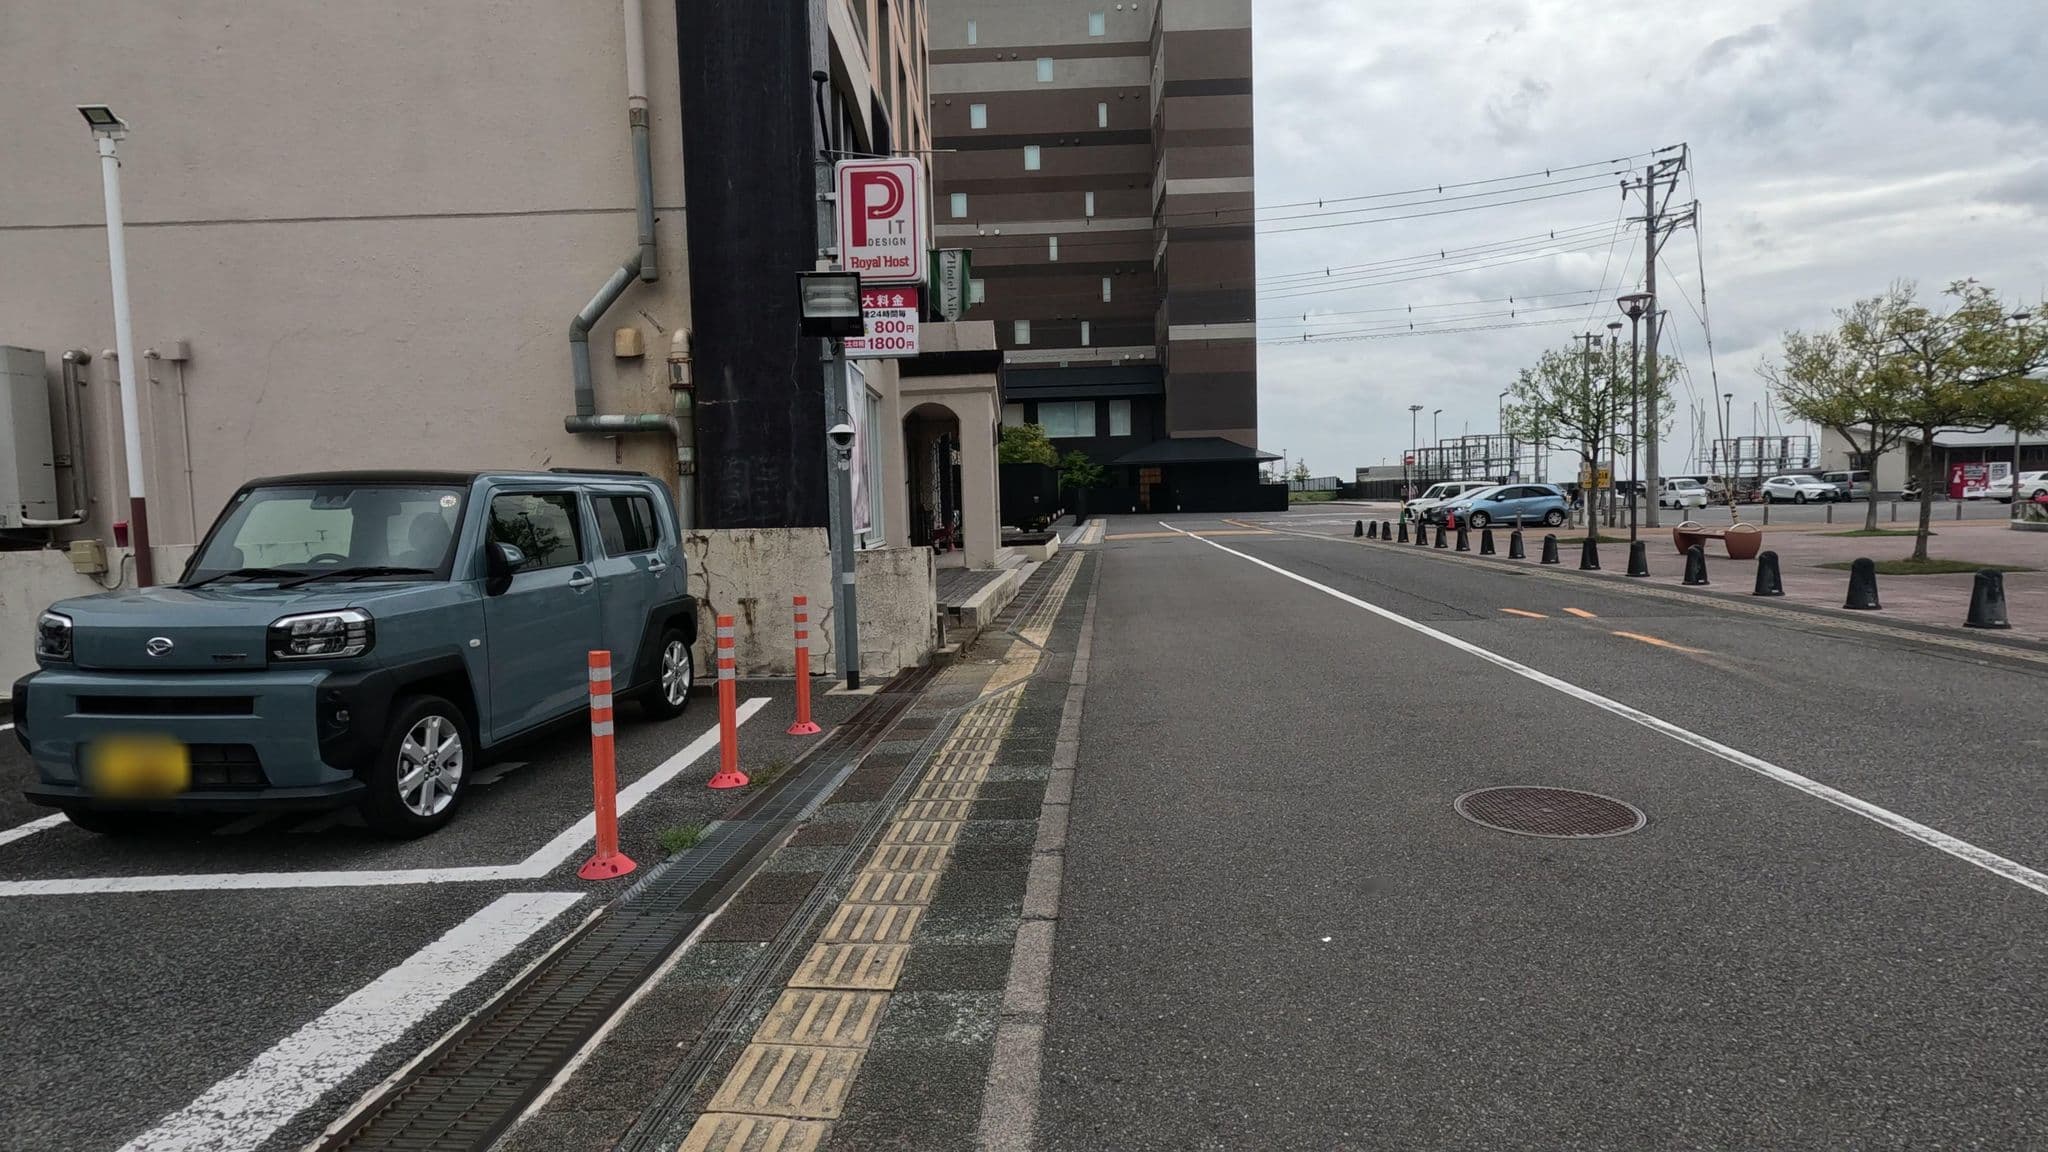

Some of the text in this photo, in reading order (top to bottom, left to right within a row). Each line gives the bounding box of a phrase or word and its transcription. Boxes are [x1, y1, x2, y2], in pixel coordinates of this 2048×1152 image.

[868, 237, 906, 247] DESIGN
[850, 255, 910, 270] Royal Host
[946, 260, 957, 291] Hotel
[874, 320, 914, 334] 800円
[868, 337, 914, 350] 1800円
